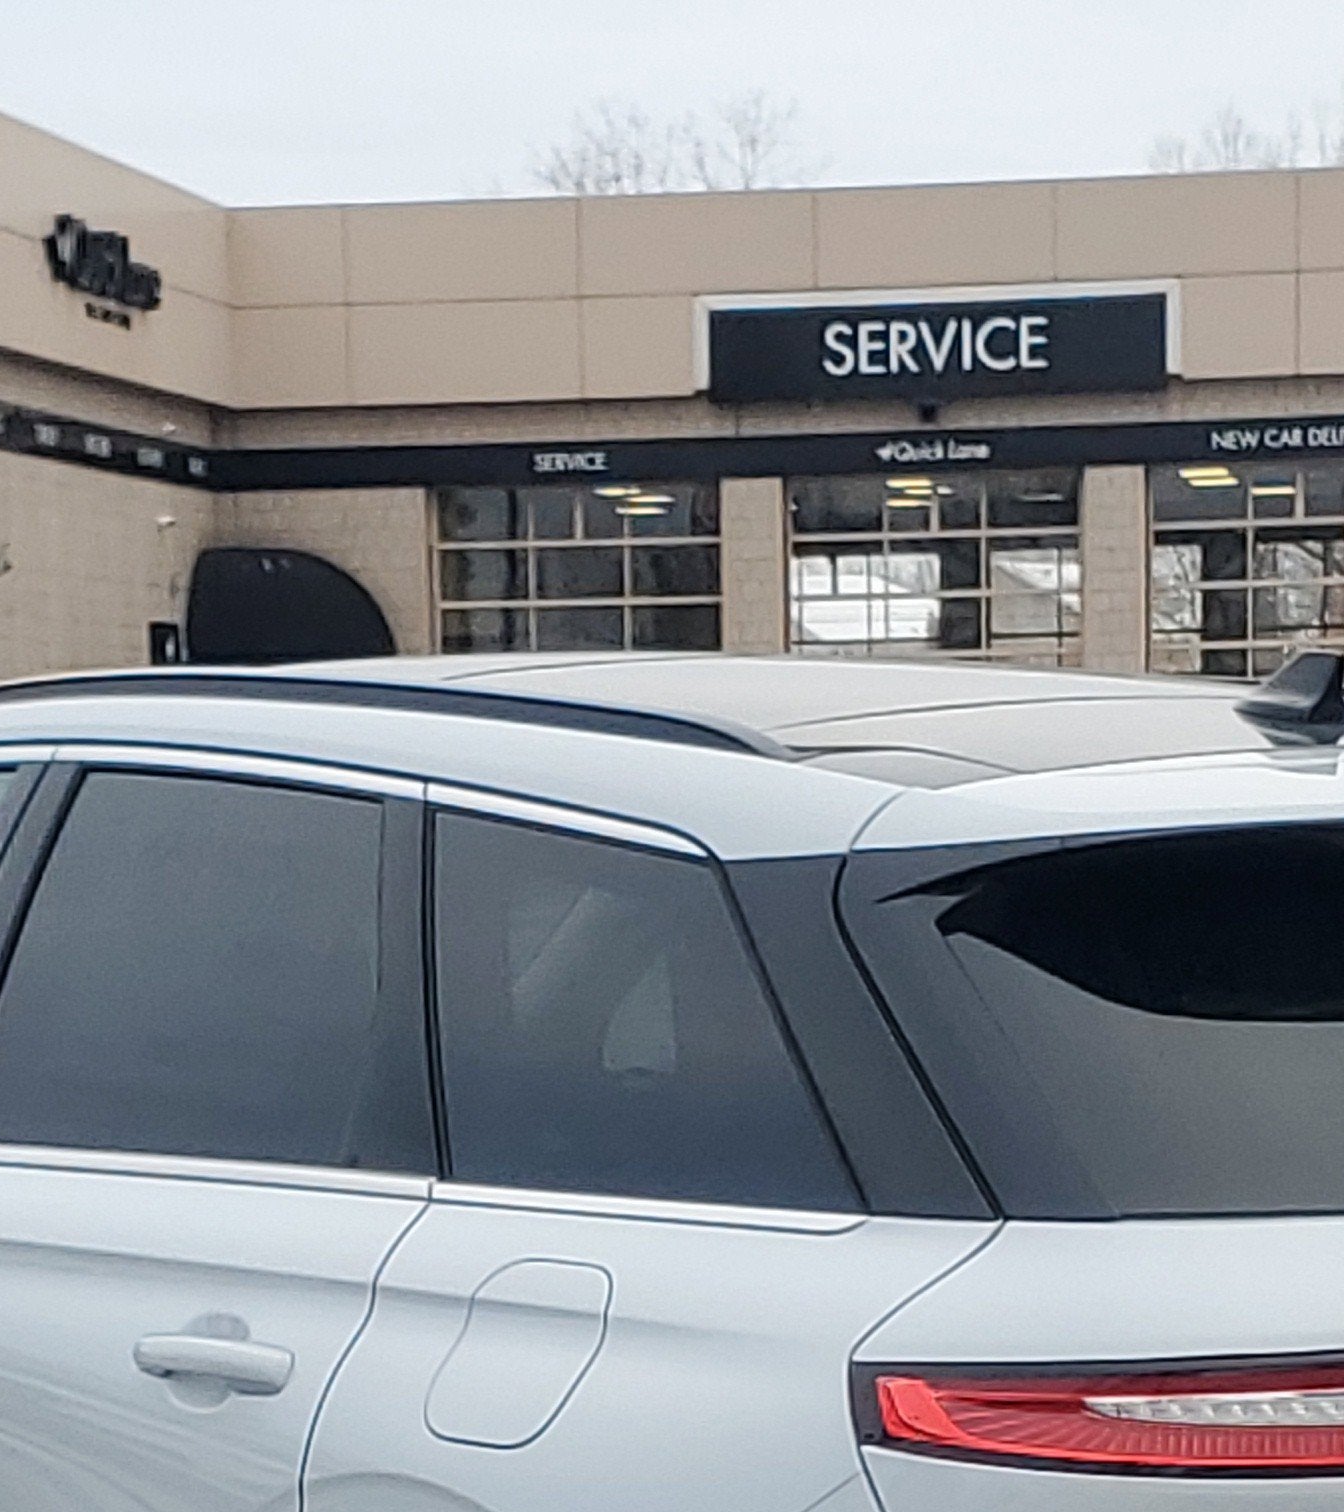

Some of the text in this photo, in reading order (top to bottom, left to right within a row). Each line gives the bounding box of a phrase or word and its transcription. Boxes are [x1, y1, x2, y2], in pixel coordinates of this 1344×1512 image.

[822, 315, 1050, 377] SERVICE
[894, 438, 990, 462] Quick Lane
[1210, 429, 1260, 451] NEW
[1263, 427, 1304, 448] CAR
[533, 451, 609, 473] SERVICE
